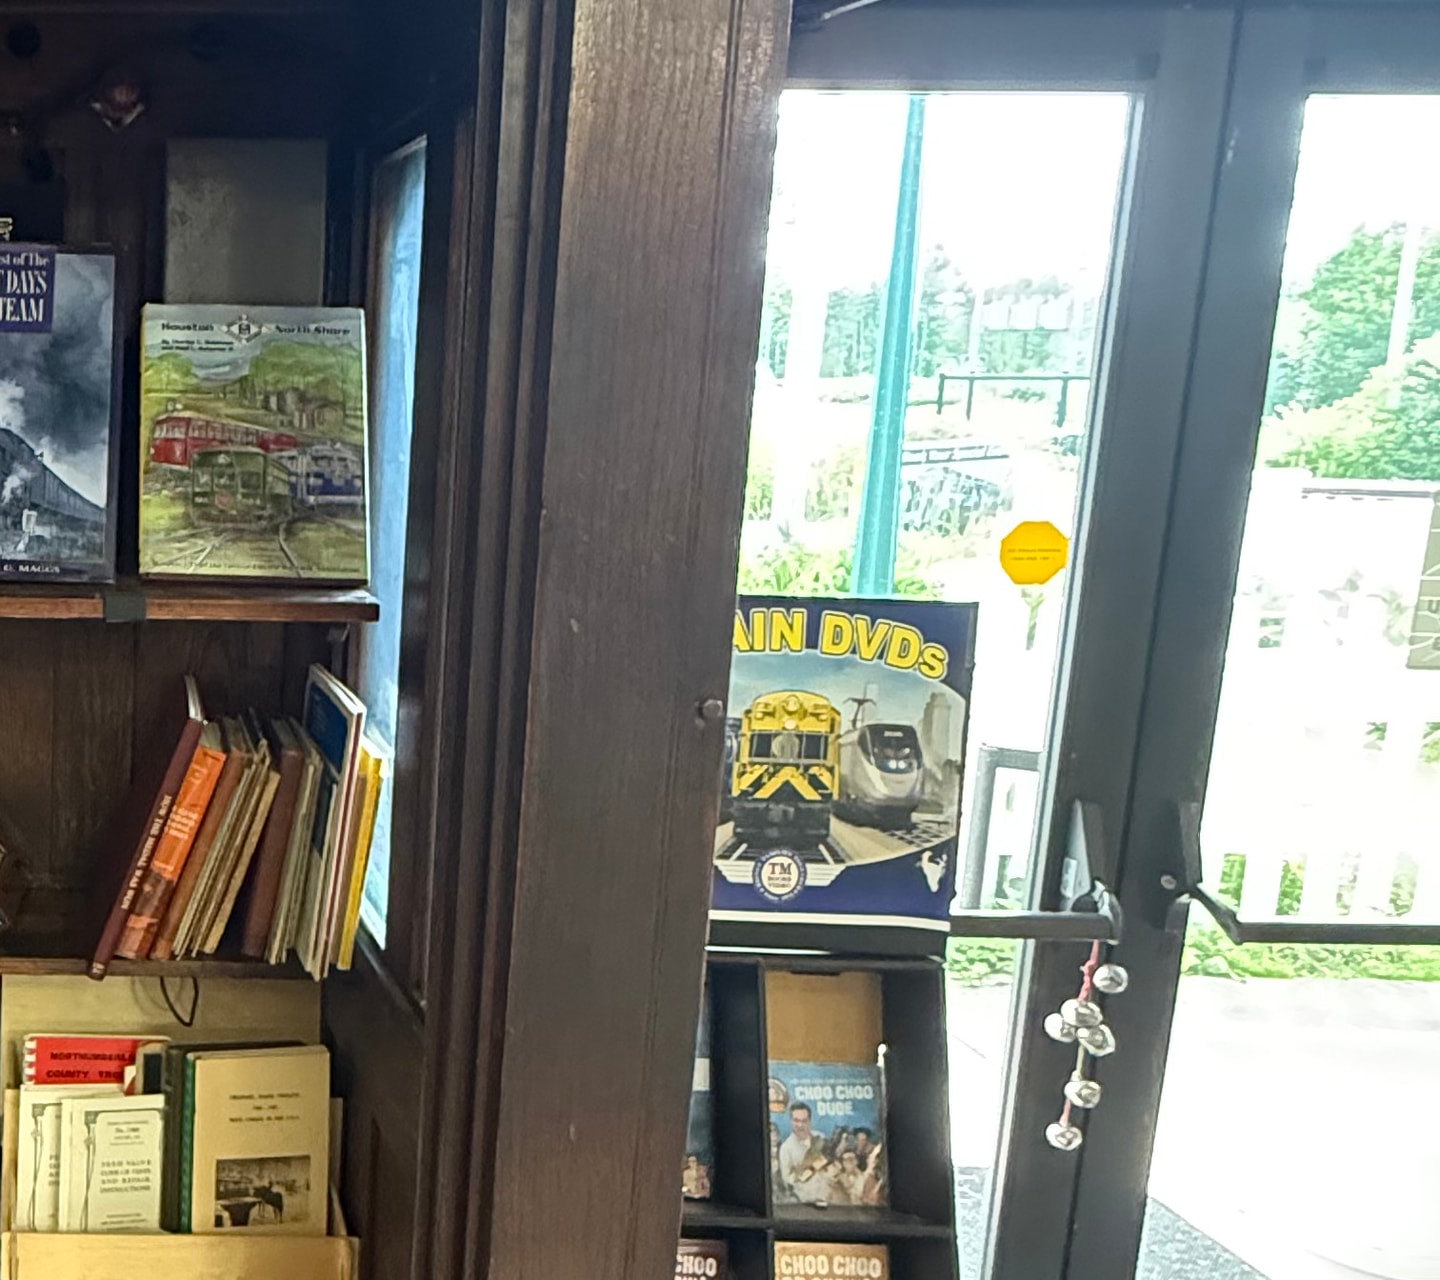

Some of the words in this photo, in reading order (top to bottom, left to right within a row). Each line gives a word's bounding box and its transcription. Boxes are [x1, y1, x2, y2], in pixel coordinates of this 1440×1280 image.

[12, 252, 27, 266] of
[27, 252, 50, 268] The
[6, 269, 47, 295] DAYS
[820, 611, 950, 680] DVDs
[768, 862, 792, 875] TM
[46, 1069, 89, 1079] COUNTY
[795, 1086, 834, 1100] CHOO
[835, 1085, 874, 1101] CHOO
[817, 1100, 853, 1116] DUDE
[780, 1254, 829, 1275] CHOO
[832, 1255, 882, 1278] CHOO
